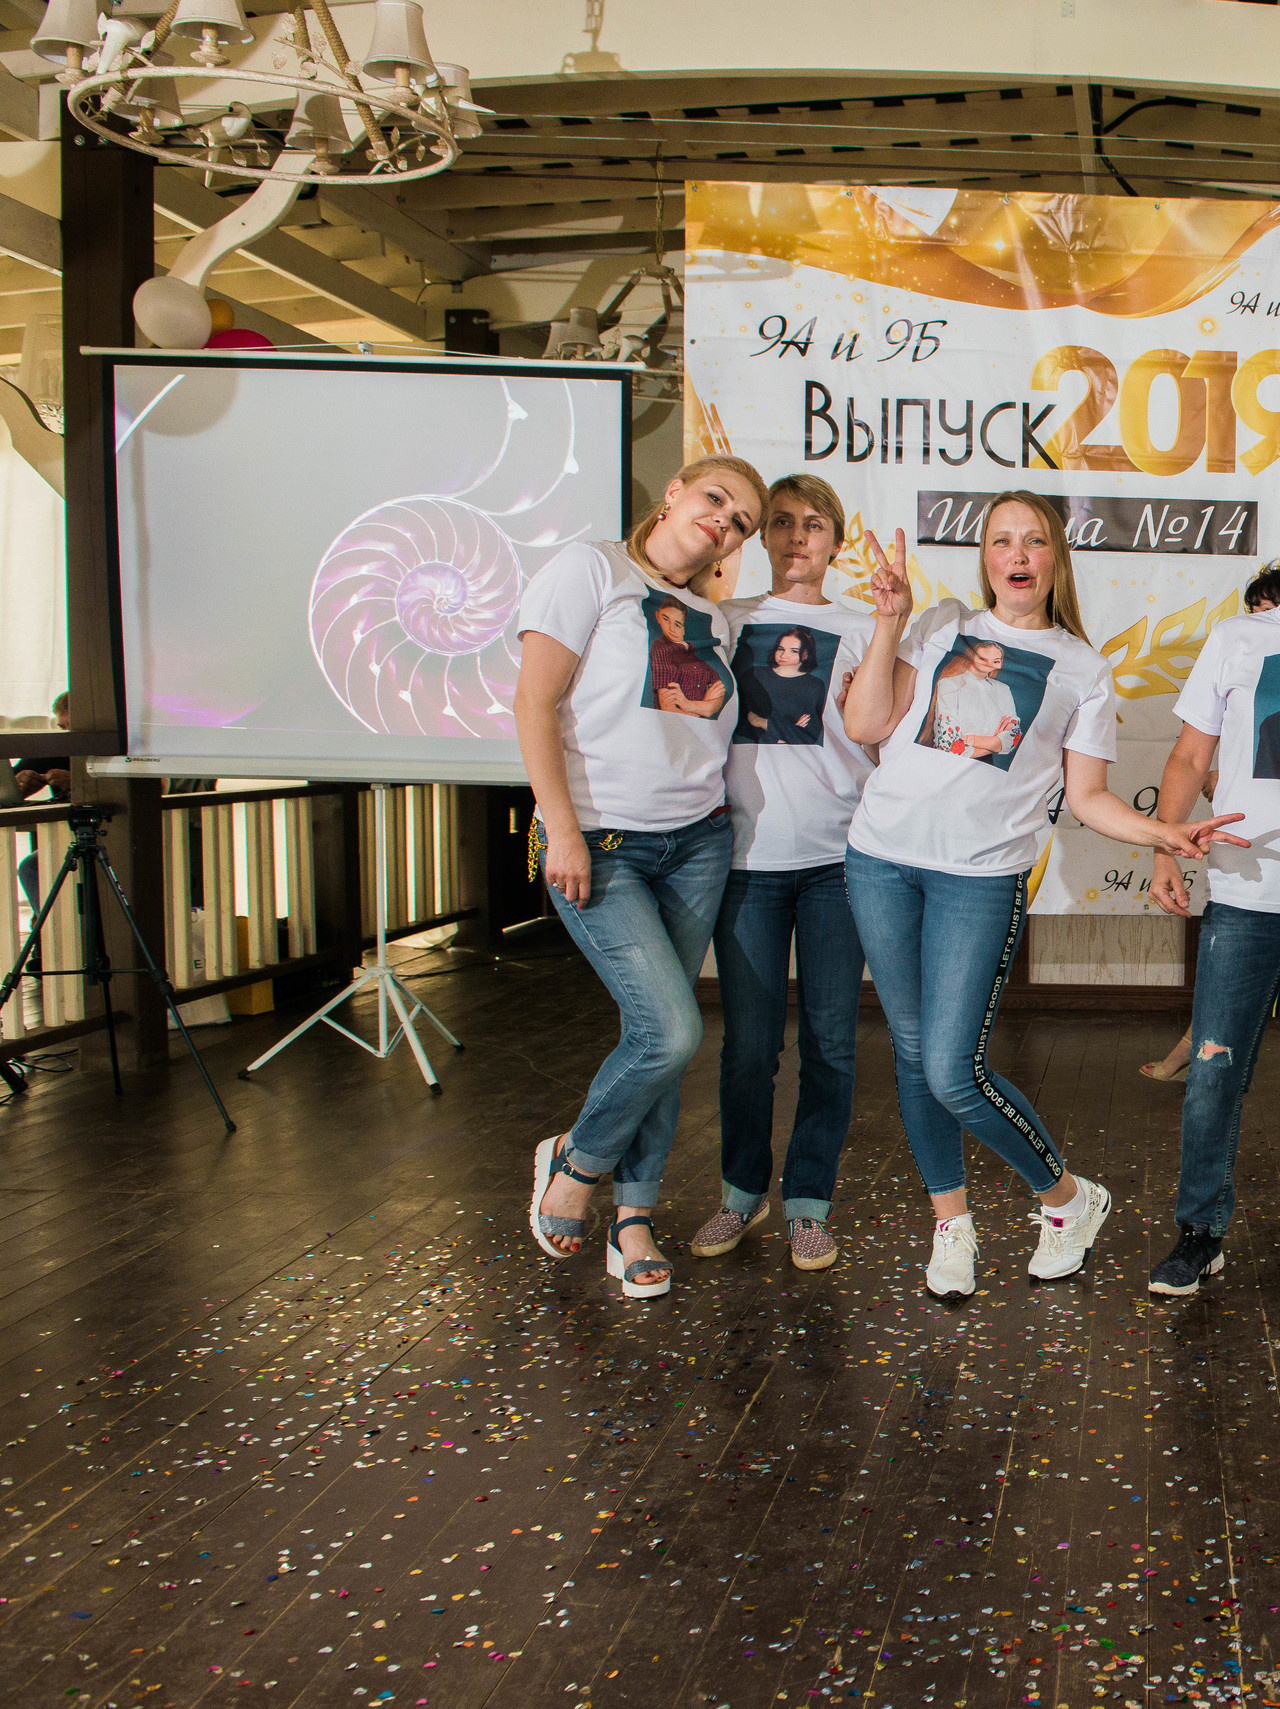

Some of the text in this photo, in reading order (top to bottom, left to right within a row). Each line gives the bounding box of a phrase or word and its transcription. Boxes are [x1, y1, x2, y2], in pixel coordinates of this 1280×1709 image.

[750, 314, 948, 362] 9А и 9Б
[804, 379, 1060, 470] Выпуск
[1100, 869, 1134, 892] 9А
[1015, 890, 1023, 906] BE
[1010, 908, 1021, 936] JUST
[1000, 936, 1015, 968] LET'S
[988, 976, 1002, 1009] GOOD
[984, 1010, 993, 1026] BE
[1001, 1103, 1016, 1118] BE
[1012, 1114, 1031, 1133] JUST
[1028, 1130, 1046, 1153] LET'S
[1045, 1153, 1061, 1177] GOOD
